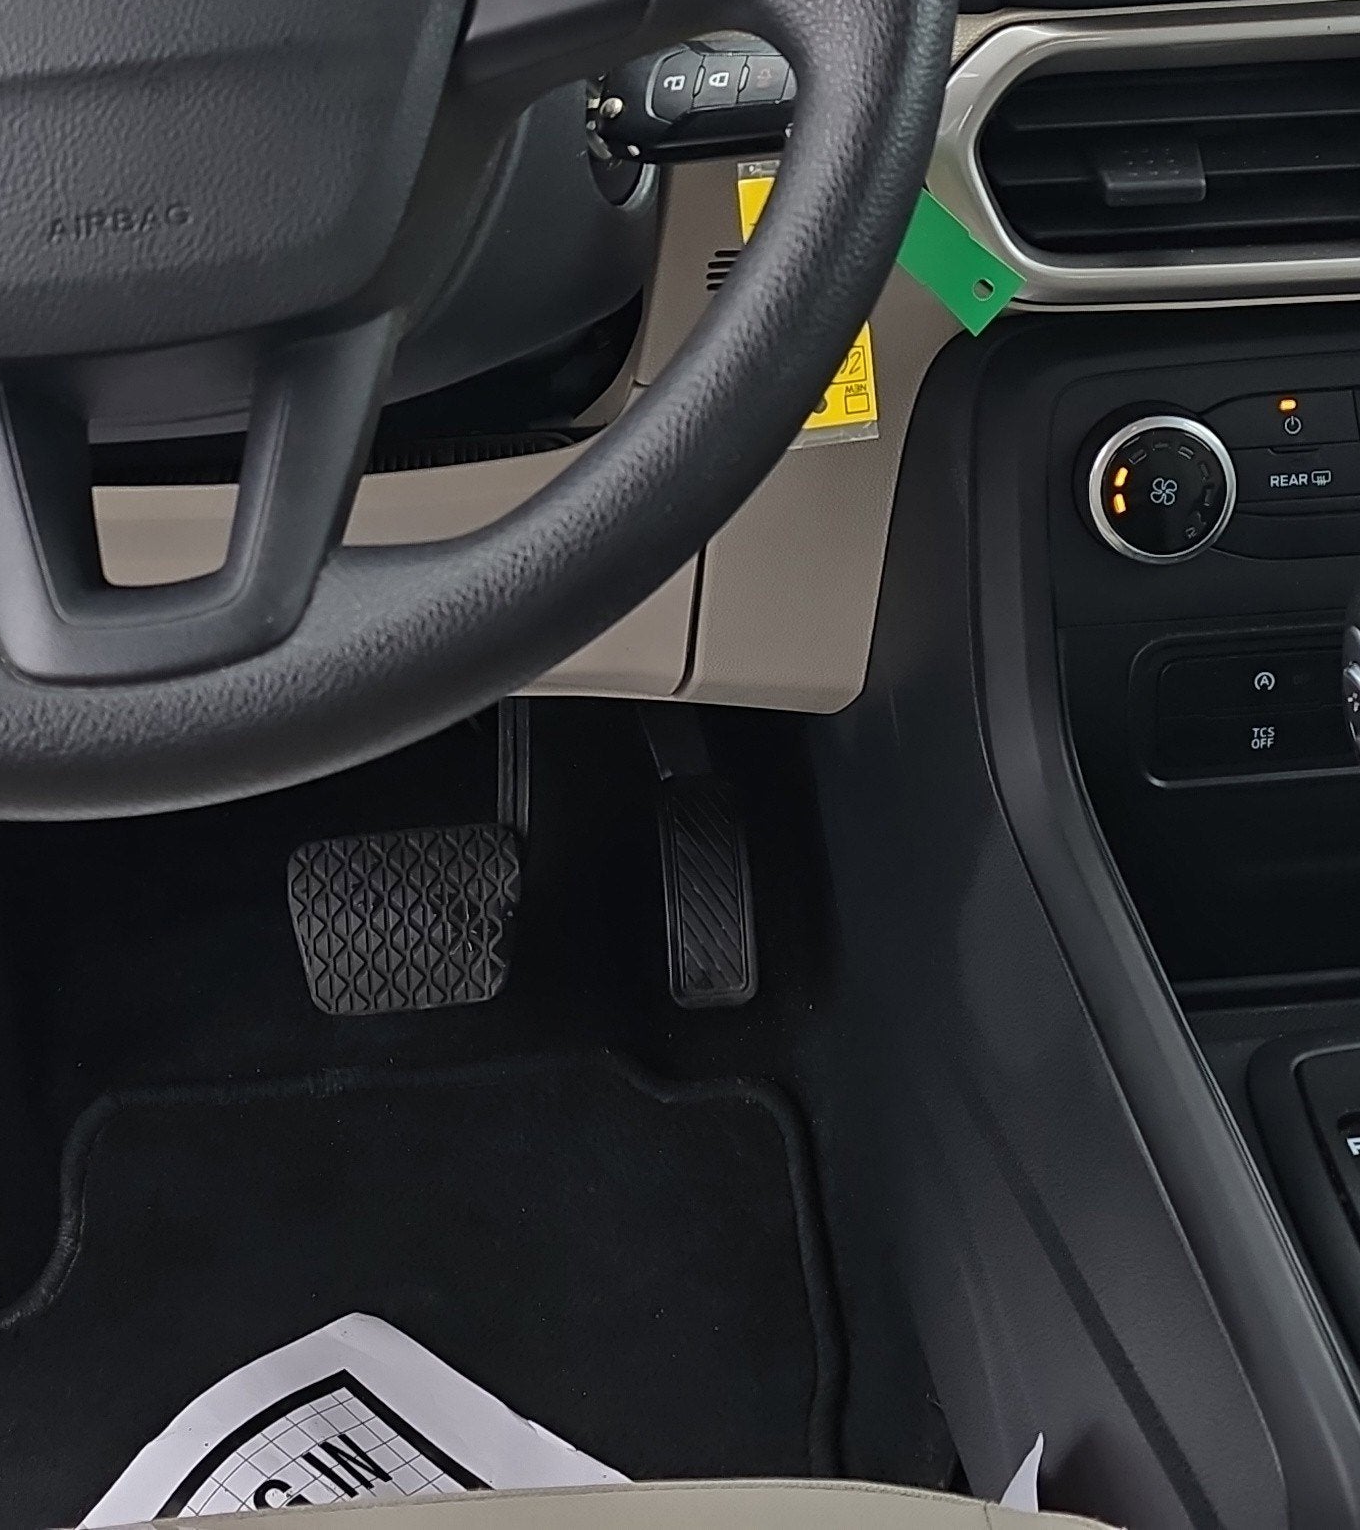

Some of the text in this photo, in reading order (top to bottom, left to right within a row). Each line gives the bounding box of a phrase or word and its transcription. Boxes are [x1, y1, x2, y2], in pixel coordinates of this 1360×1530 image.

[1269, 473, 1309, 488] REAR
[1251, 726, 1276, 738] TCS
[1250, 738, 1275, 750] OFF
[301, 1433, 394, 1500] IN
